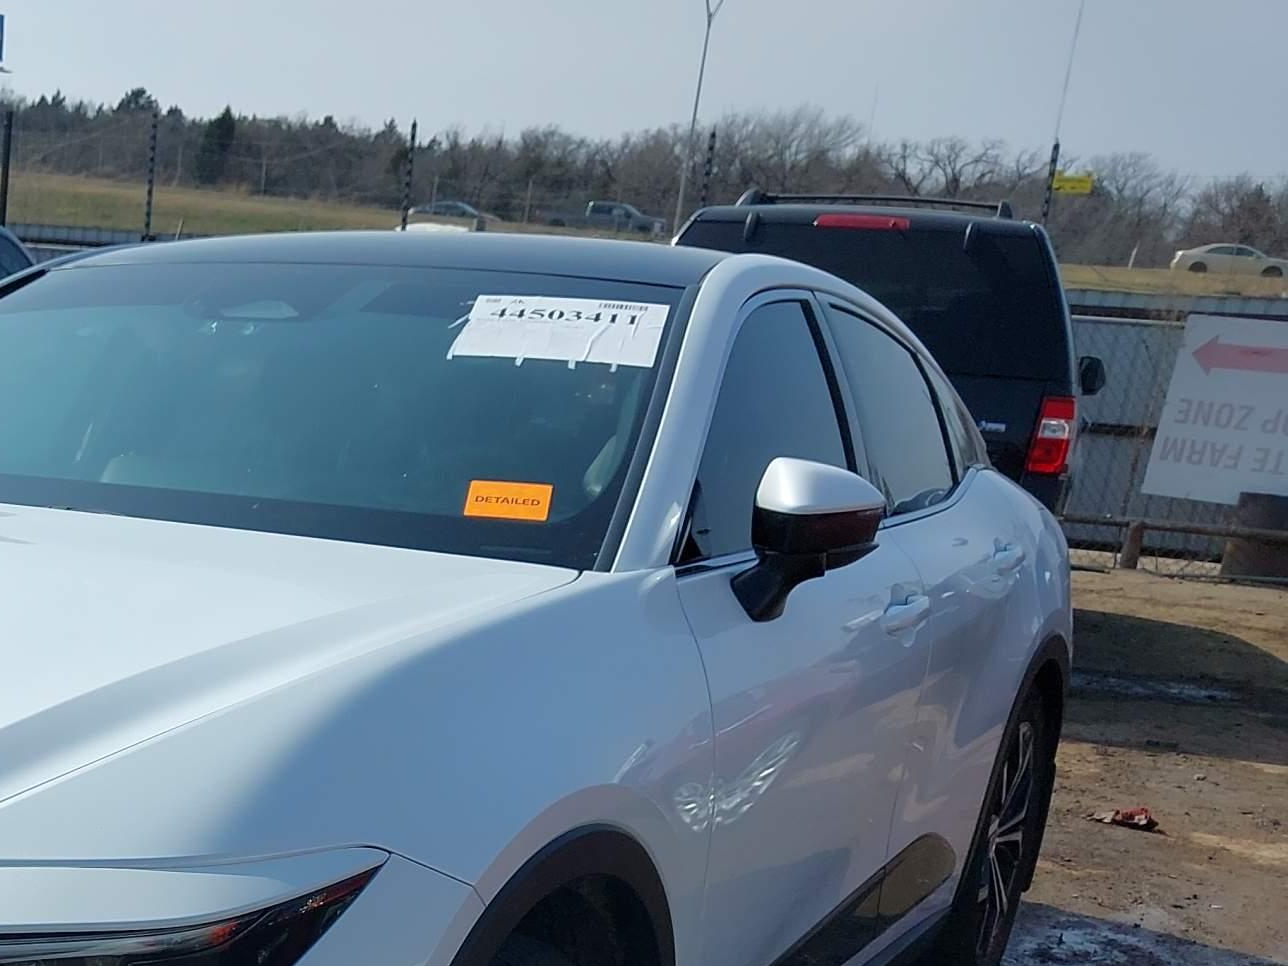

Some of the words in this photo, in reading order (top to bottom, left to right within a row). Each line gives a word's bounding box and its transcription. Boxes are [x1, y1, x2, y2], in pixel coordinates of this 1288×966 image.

[489, 305, 639, 326] 44503411
[1173, 398, 1256, 432] ZONE
[1159, 436, 1245, 471] FARM
[474, 494, 542, 507] DETAILED
